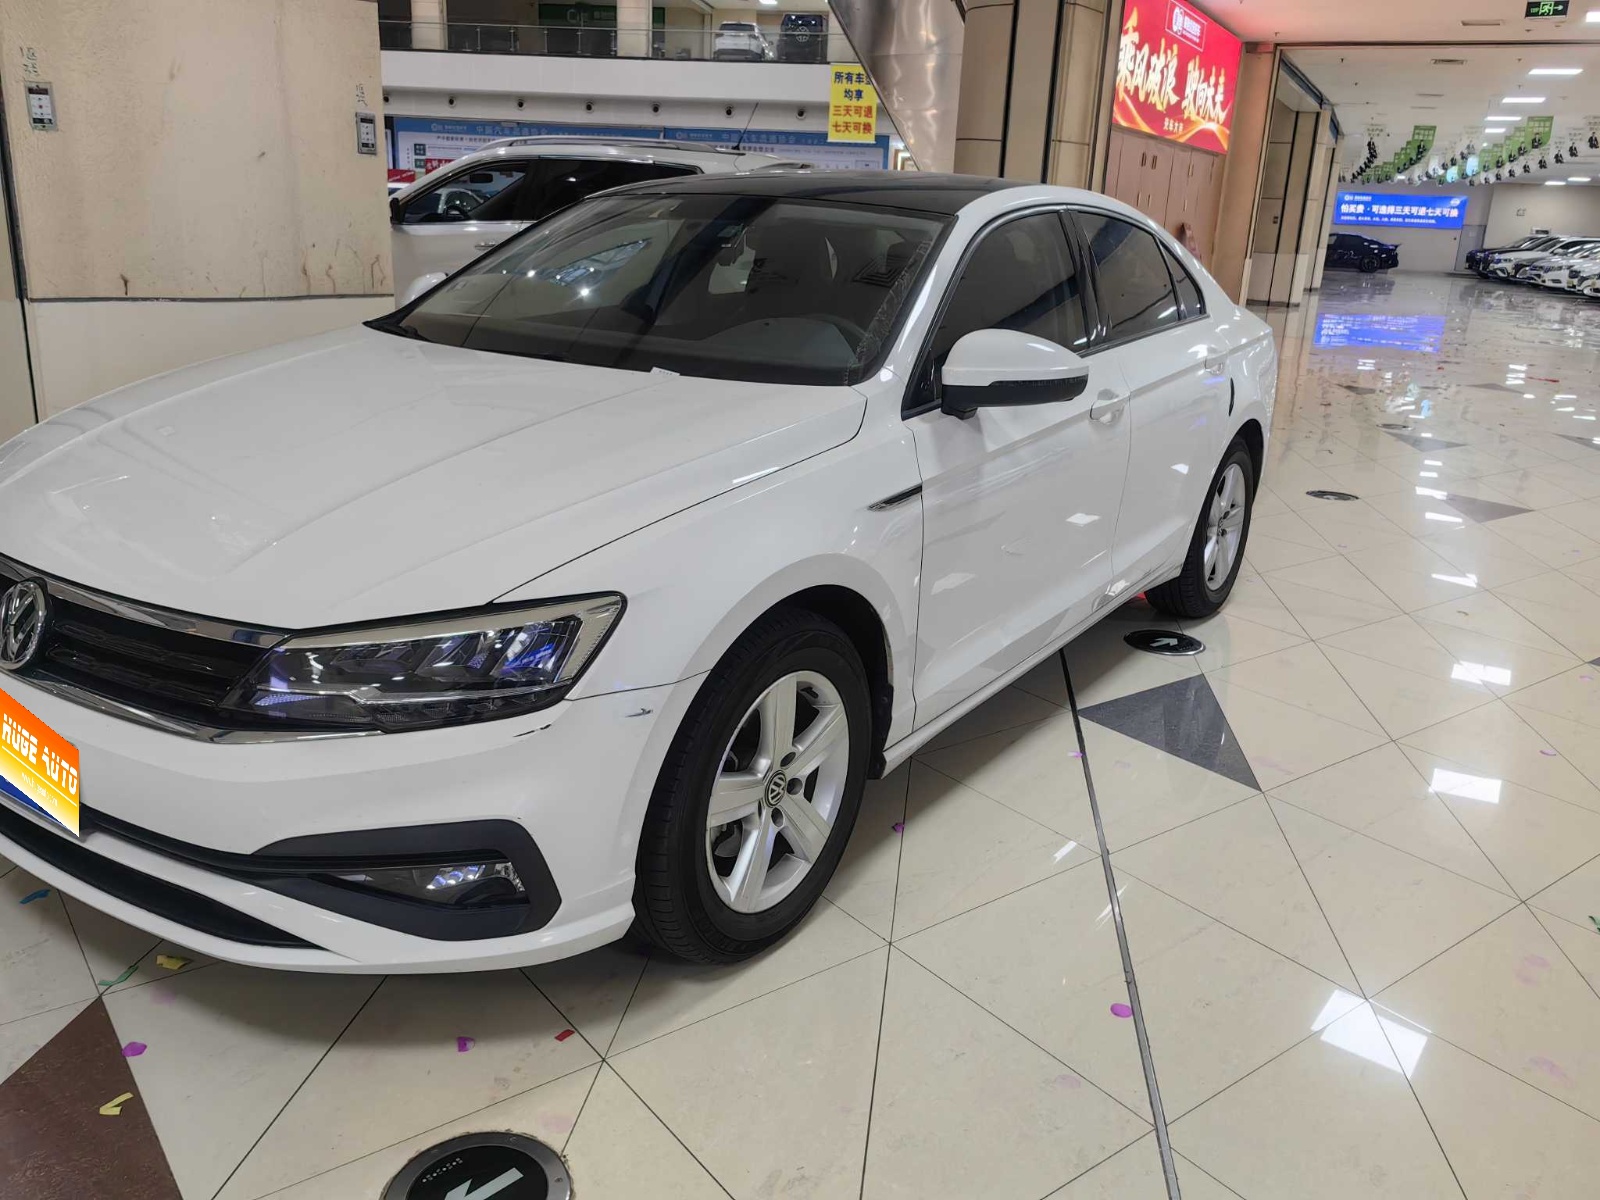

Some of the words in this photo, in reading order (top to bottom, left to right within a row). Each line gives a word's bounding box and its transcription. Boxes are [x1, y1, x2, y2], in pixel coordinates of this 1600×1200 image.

[844, 89, 864, 102] 均享
[832, 105, 873, 118] 三天可退
[832, 121, 873, 134] 七天可换
